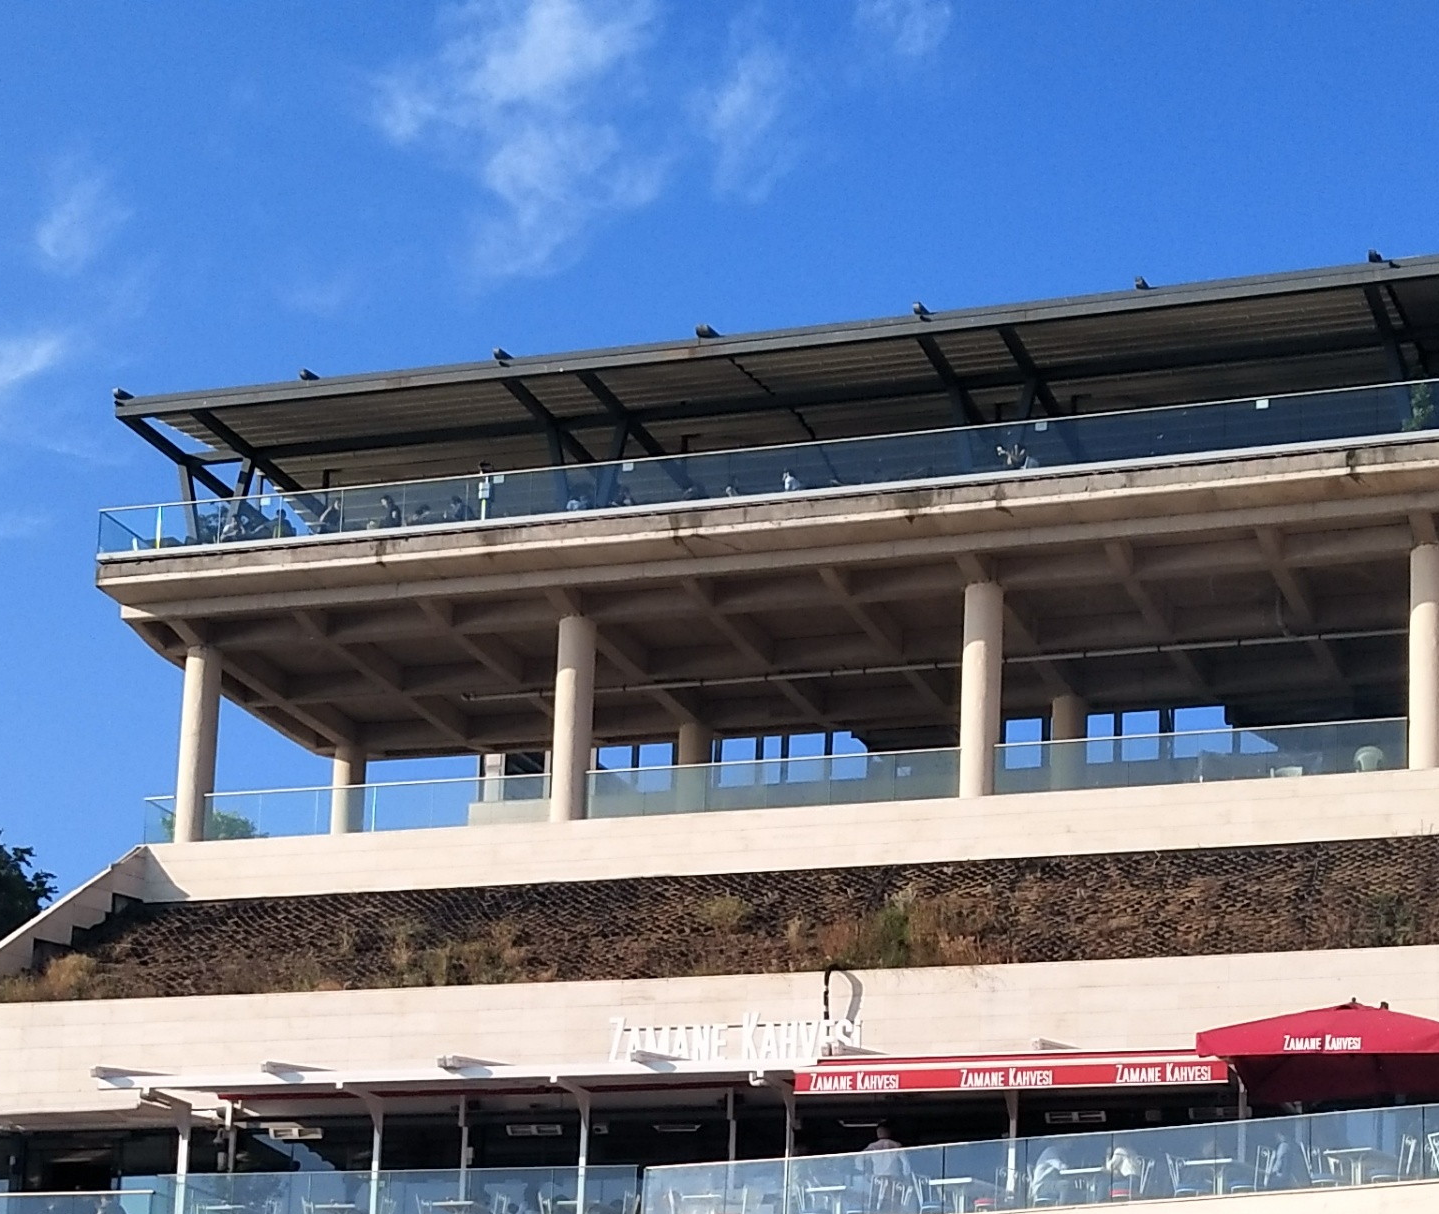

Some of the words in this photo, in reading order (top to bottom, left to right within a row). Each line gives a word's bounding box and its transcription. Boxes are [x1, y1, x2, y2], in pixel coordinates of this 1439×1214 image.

[608, 1016, 728, 1062] ZAMANE
[1283, 1034, 1322, 1051] ZAMANE
[810, 1073, 853, 1091] ZAMANE
[960, 1069, 1004, 1087] ZAMANE
[1116, 1064, 1162, 1083] ZAMANE
